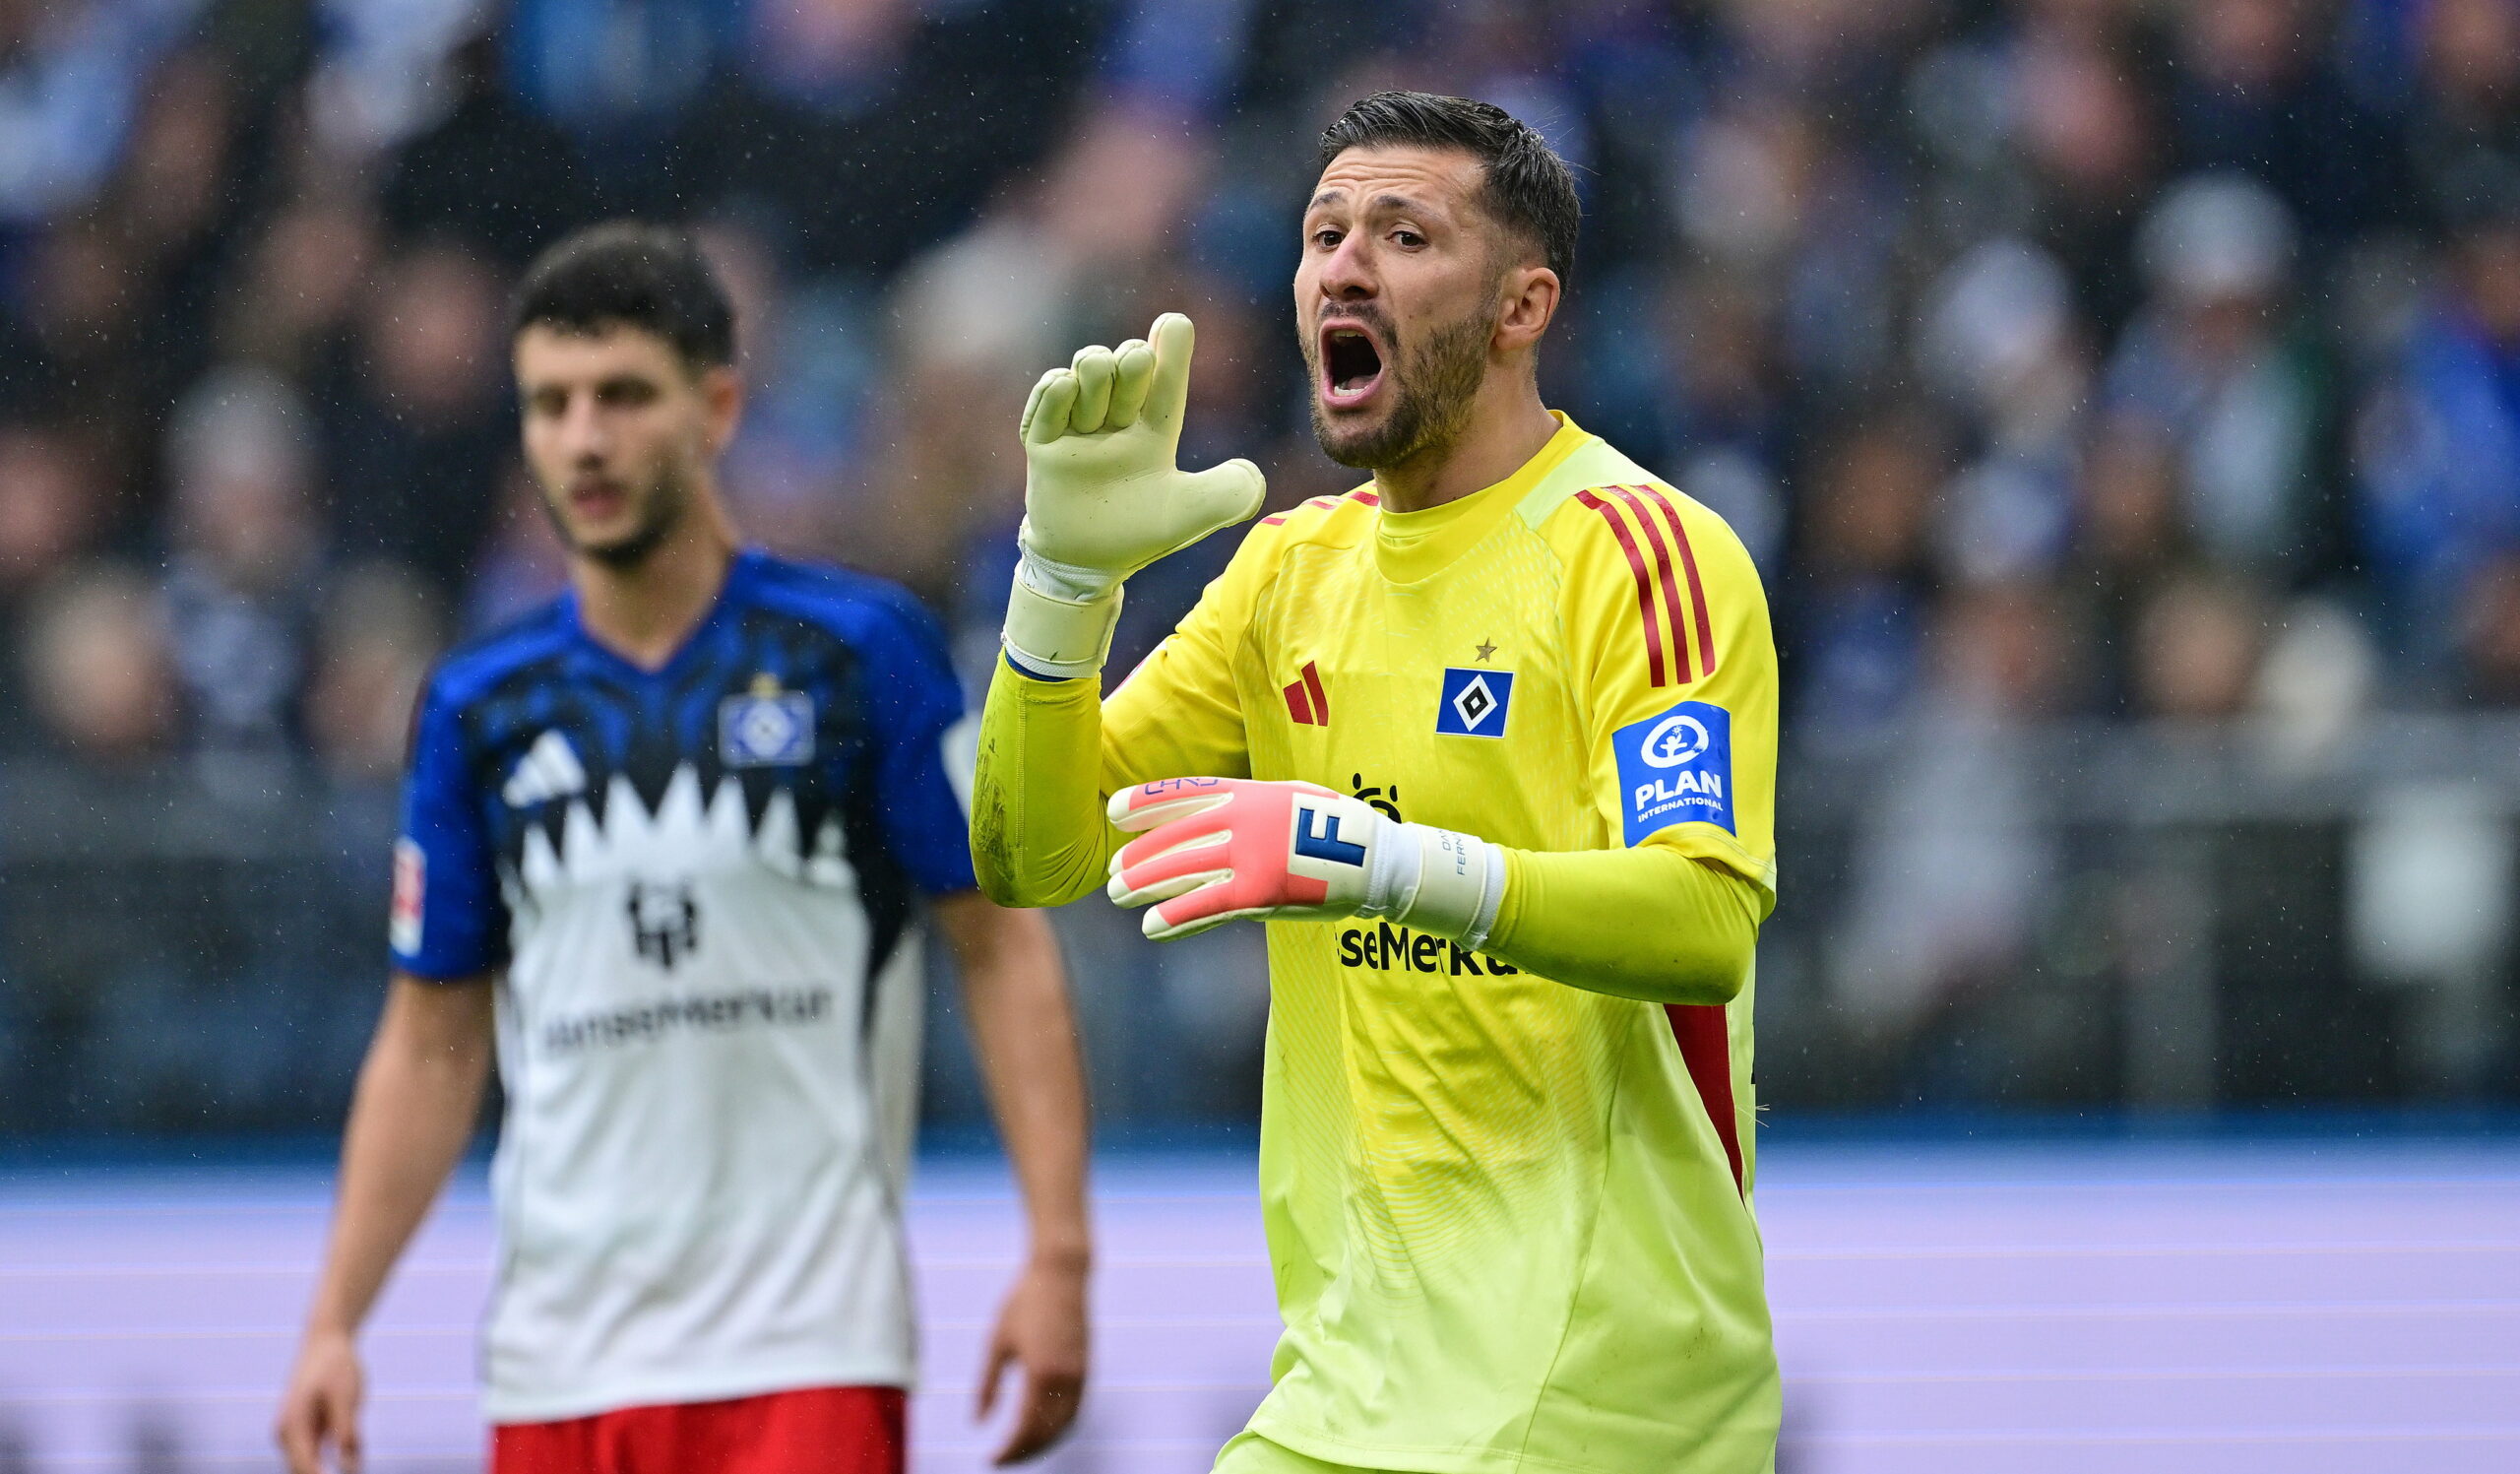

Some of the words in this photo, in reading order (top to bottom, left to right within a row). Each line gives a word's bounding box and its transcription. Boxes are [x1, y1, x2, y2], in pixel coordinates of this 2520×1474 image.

[1635, 770, 1722, 811] PLAN
[1638, 797, 1724, 823] INTERNATIONAL
[1294, 806, 1366, 867] F
[1454, 834, 1466, 875] FERN
[1335, 922, 1530, 976] seMerku
